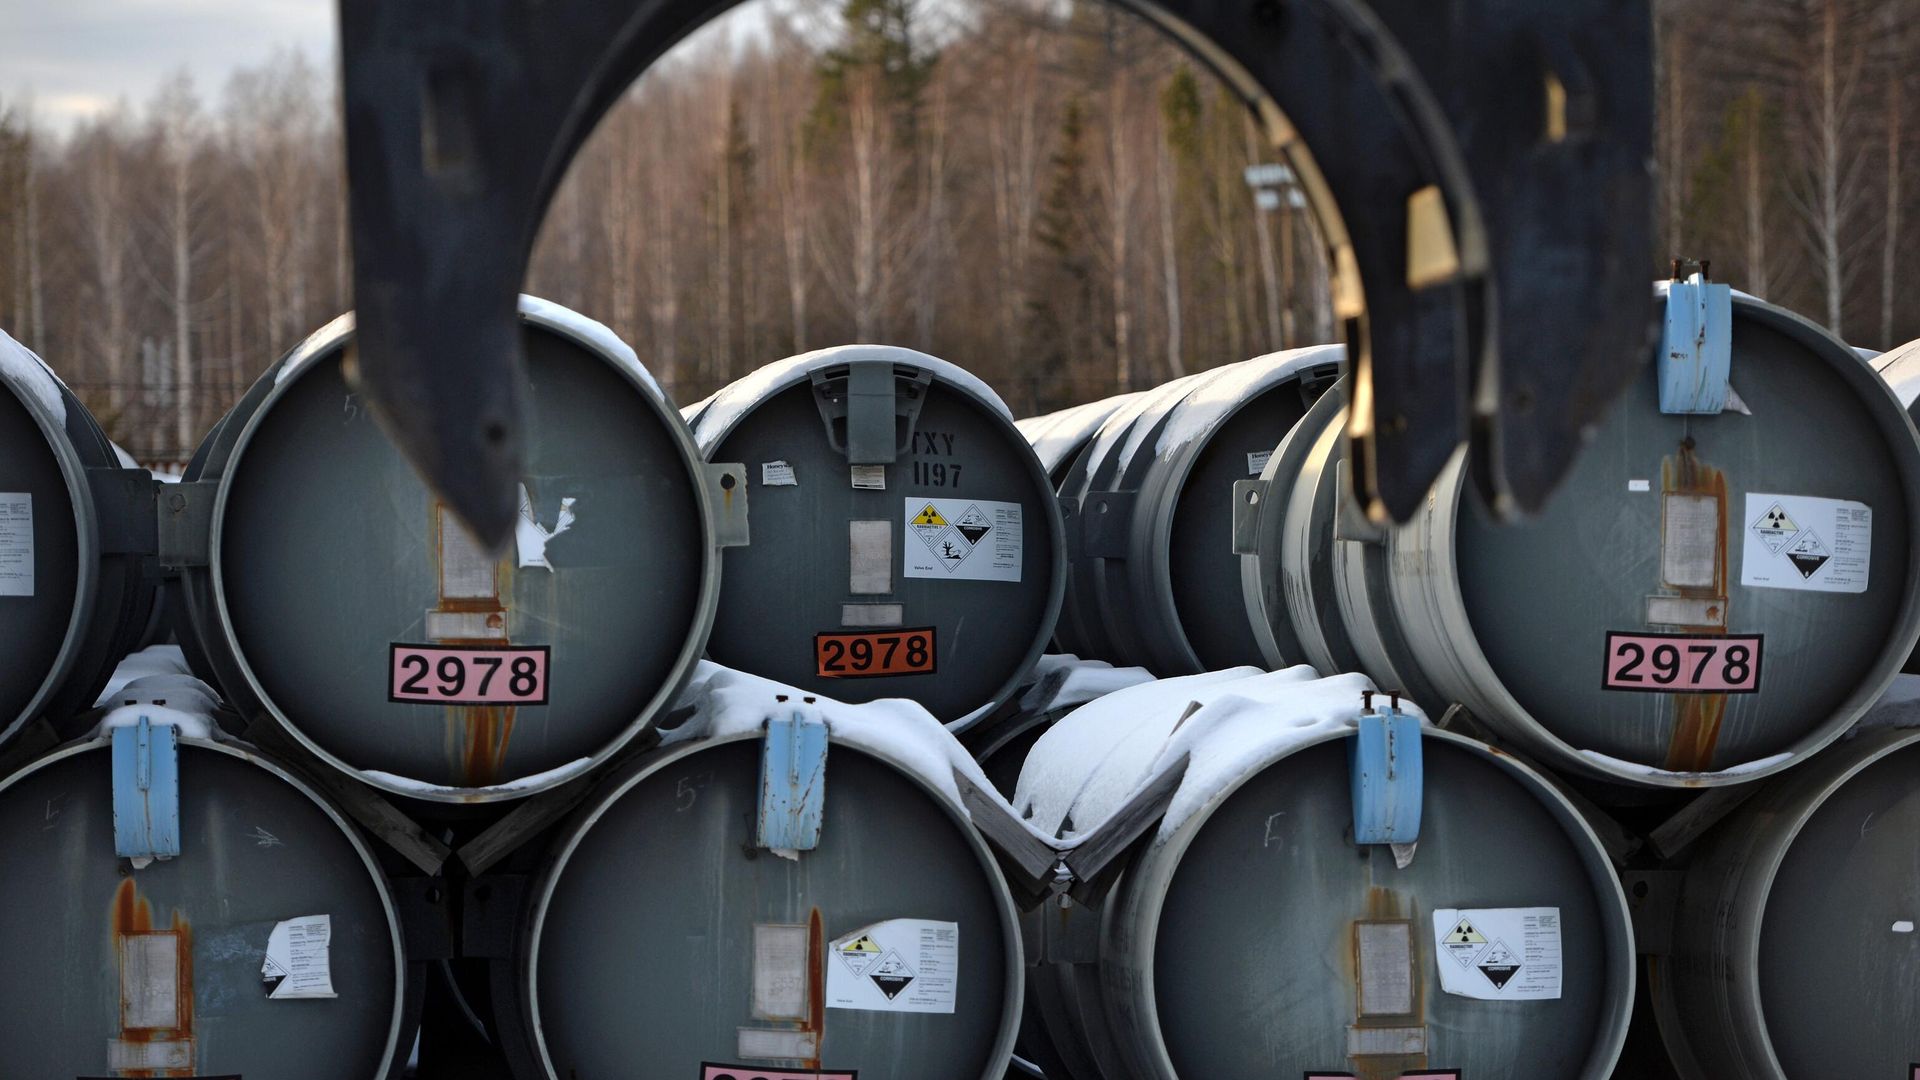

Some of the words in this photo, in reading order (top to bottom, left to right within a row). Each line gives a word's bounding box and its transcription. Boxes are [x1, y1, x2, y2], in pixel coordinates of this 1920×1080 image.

[914, 461, 962, 488] 1197
[823, 635, 928, 672] 2978
[1614, 643, 1750, 684] 2978
[400, 655, 537, 697] 2978
